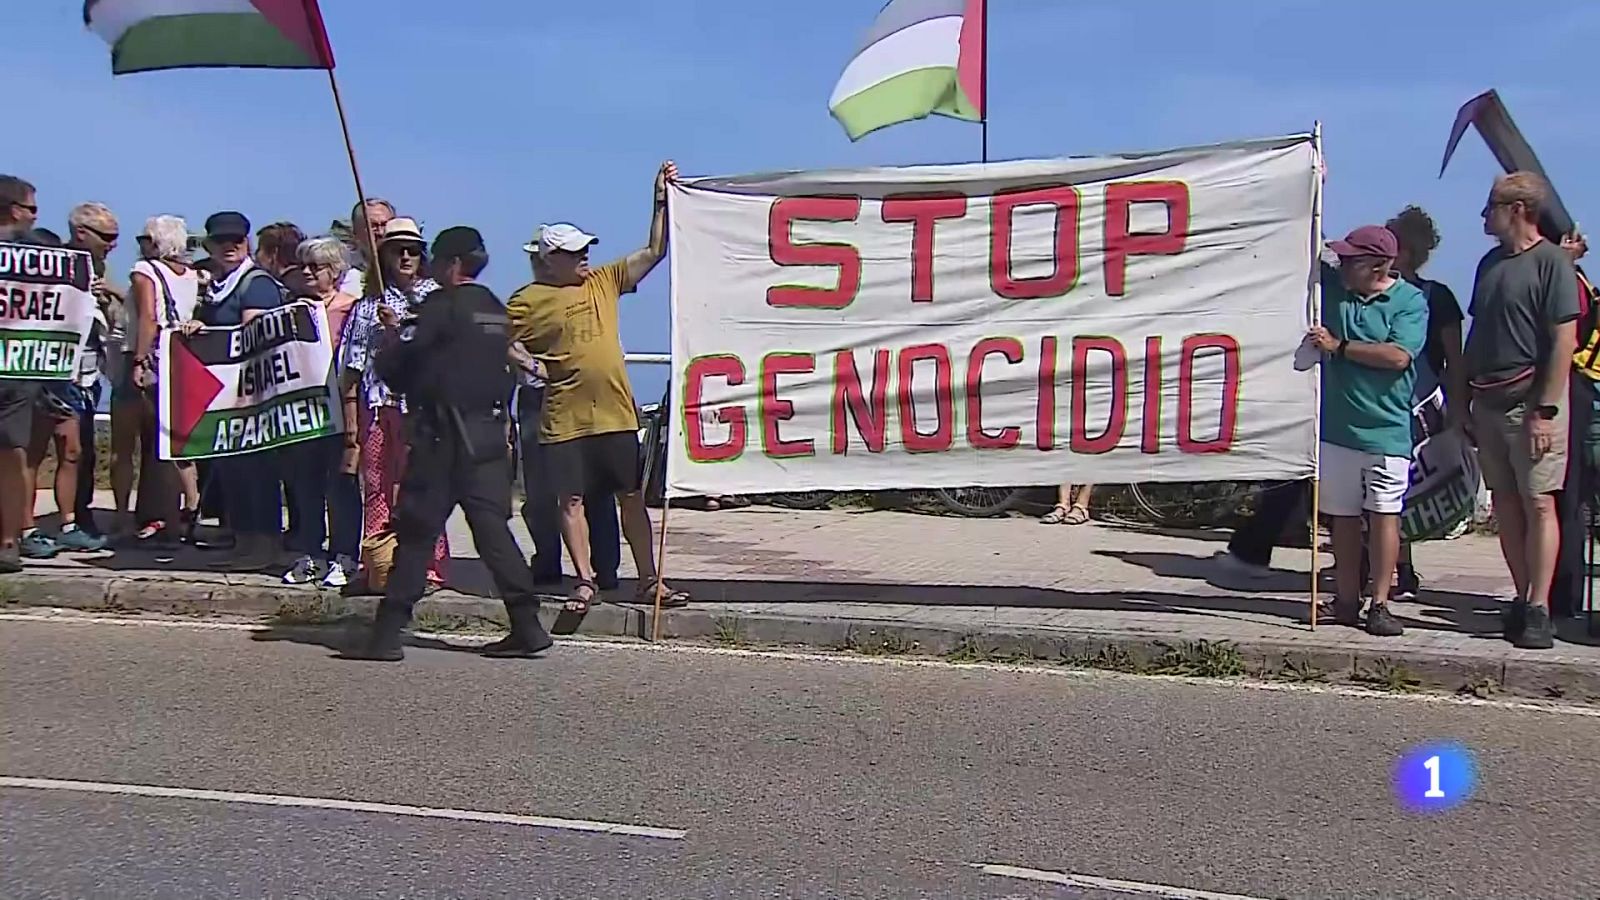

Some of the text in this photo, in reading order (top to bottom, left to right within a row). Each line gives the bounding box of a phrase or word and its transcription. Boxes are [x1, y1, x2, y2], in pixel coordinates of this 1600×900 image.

[767, 179, 1191, 309] STOP
[237, 350, 300, 398] ISRAEL
[684, 333, 1241, 463] GENOCIDIO
